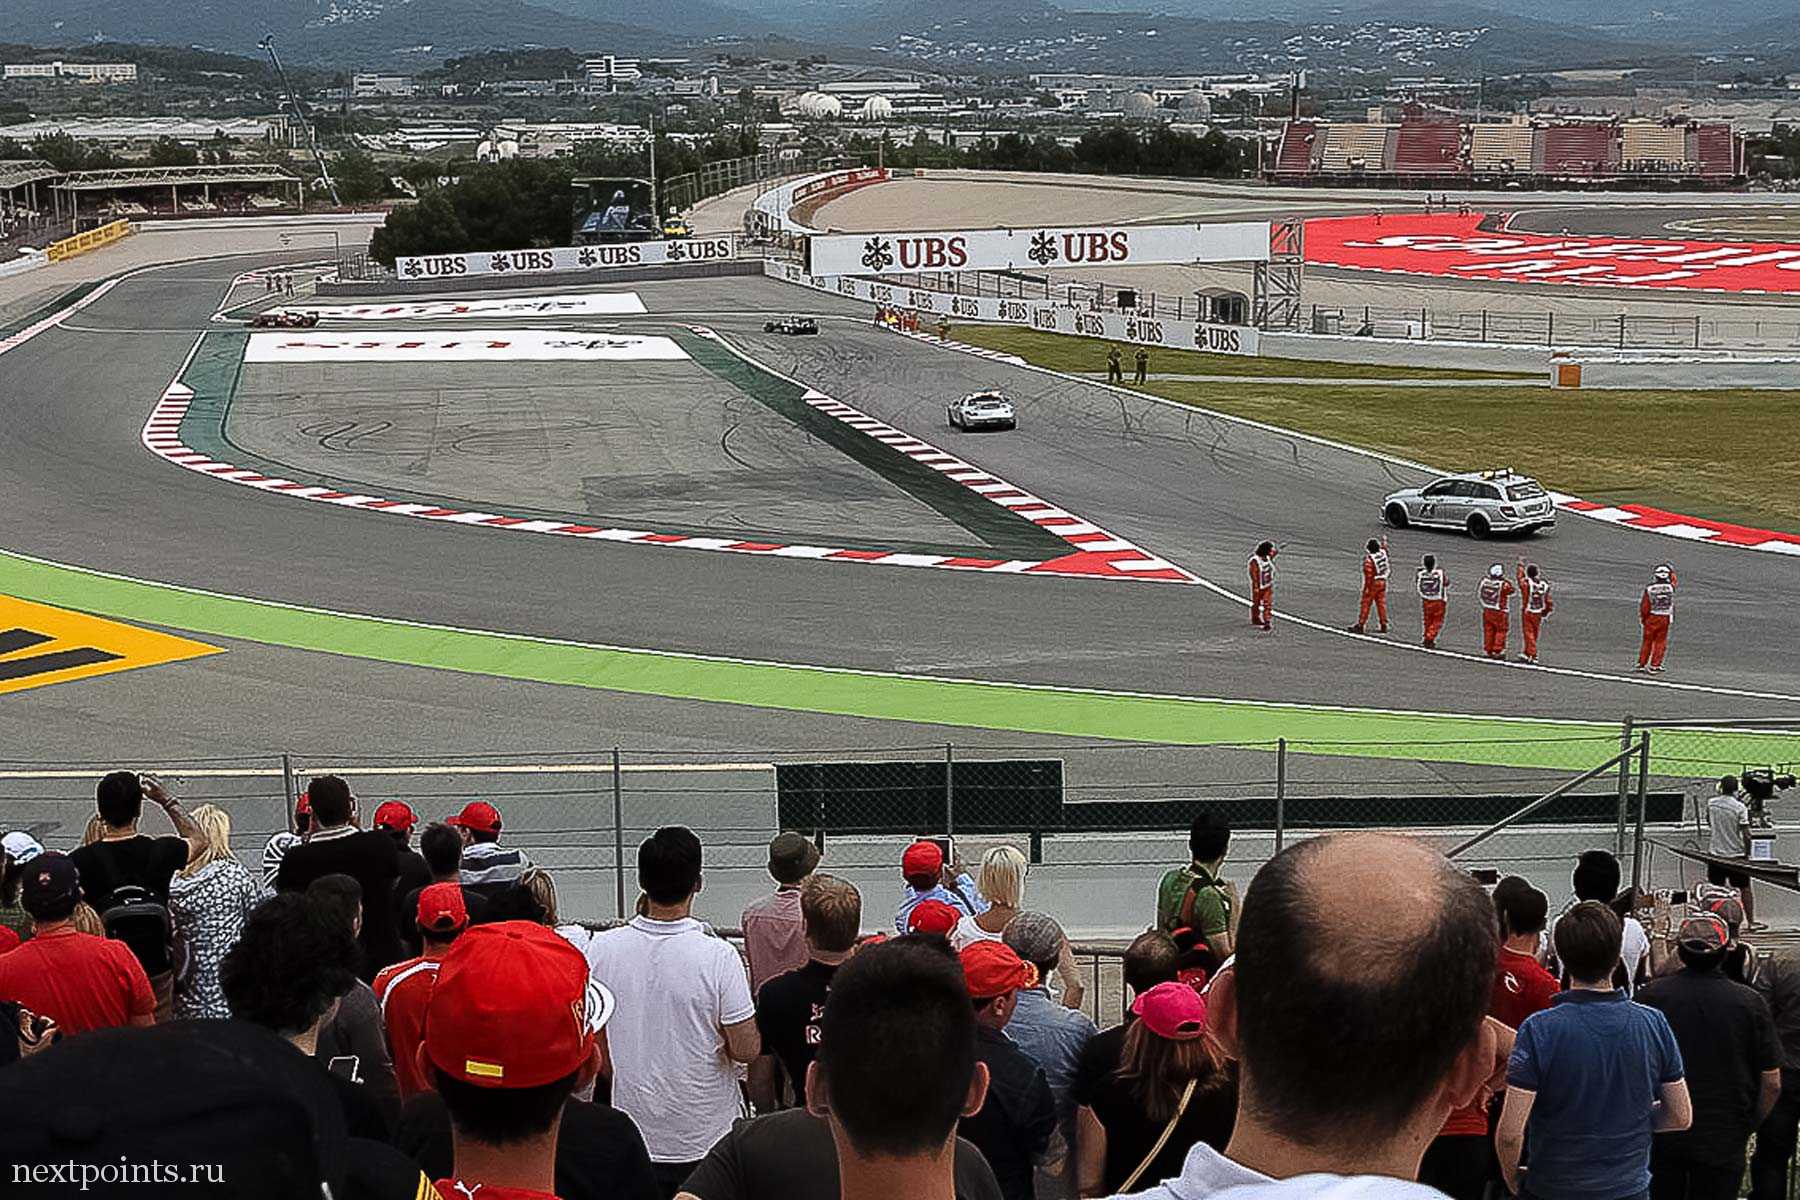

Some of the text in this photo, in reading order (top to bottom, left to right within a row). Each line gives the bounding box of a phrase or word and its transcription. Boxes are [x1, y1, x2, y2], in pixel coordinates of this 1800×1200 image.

[599, 245, 641, 265] UBS
[686, 240, 729, 260] UBS
[897, 236, 968, 268] UBS
[1062, 231, 1129, 262] UBS
[426, 256, 467, 275] UBS
[510, 251, 553, 271] UBS
[1007, 301, 1028, 320] UBS
[1082, 313, 1105, 335] UBS
[1137, 319, 1164, 343] UBS
[1208, 327, 1240, 352] UBS
